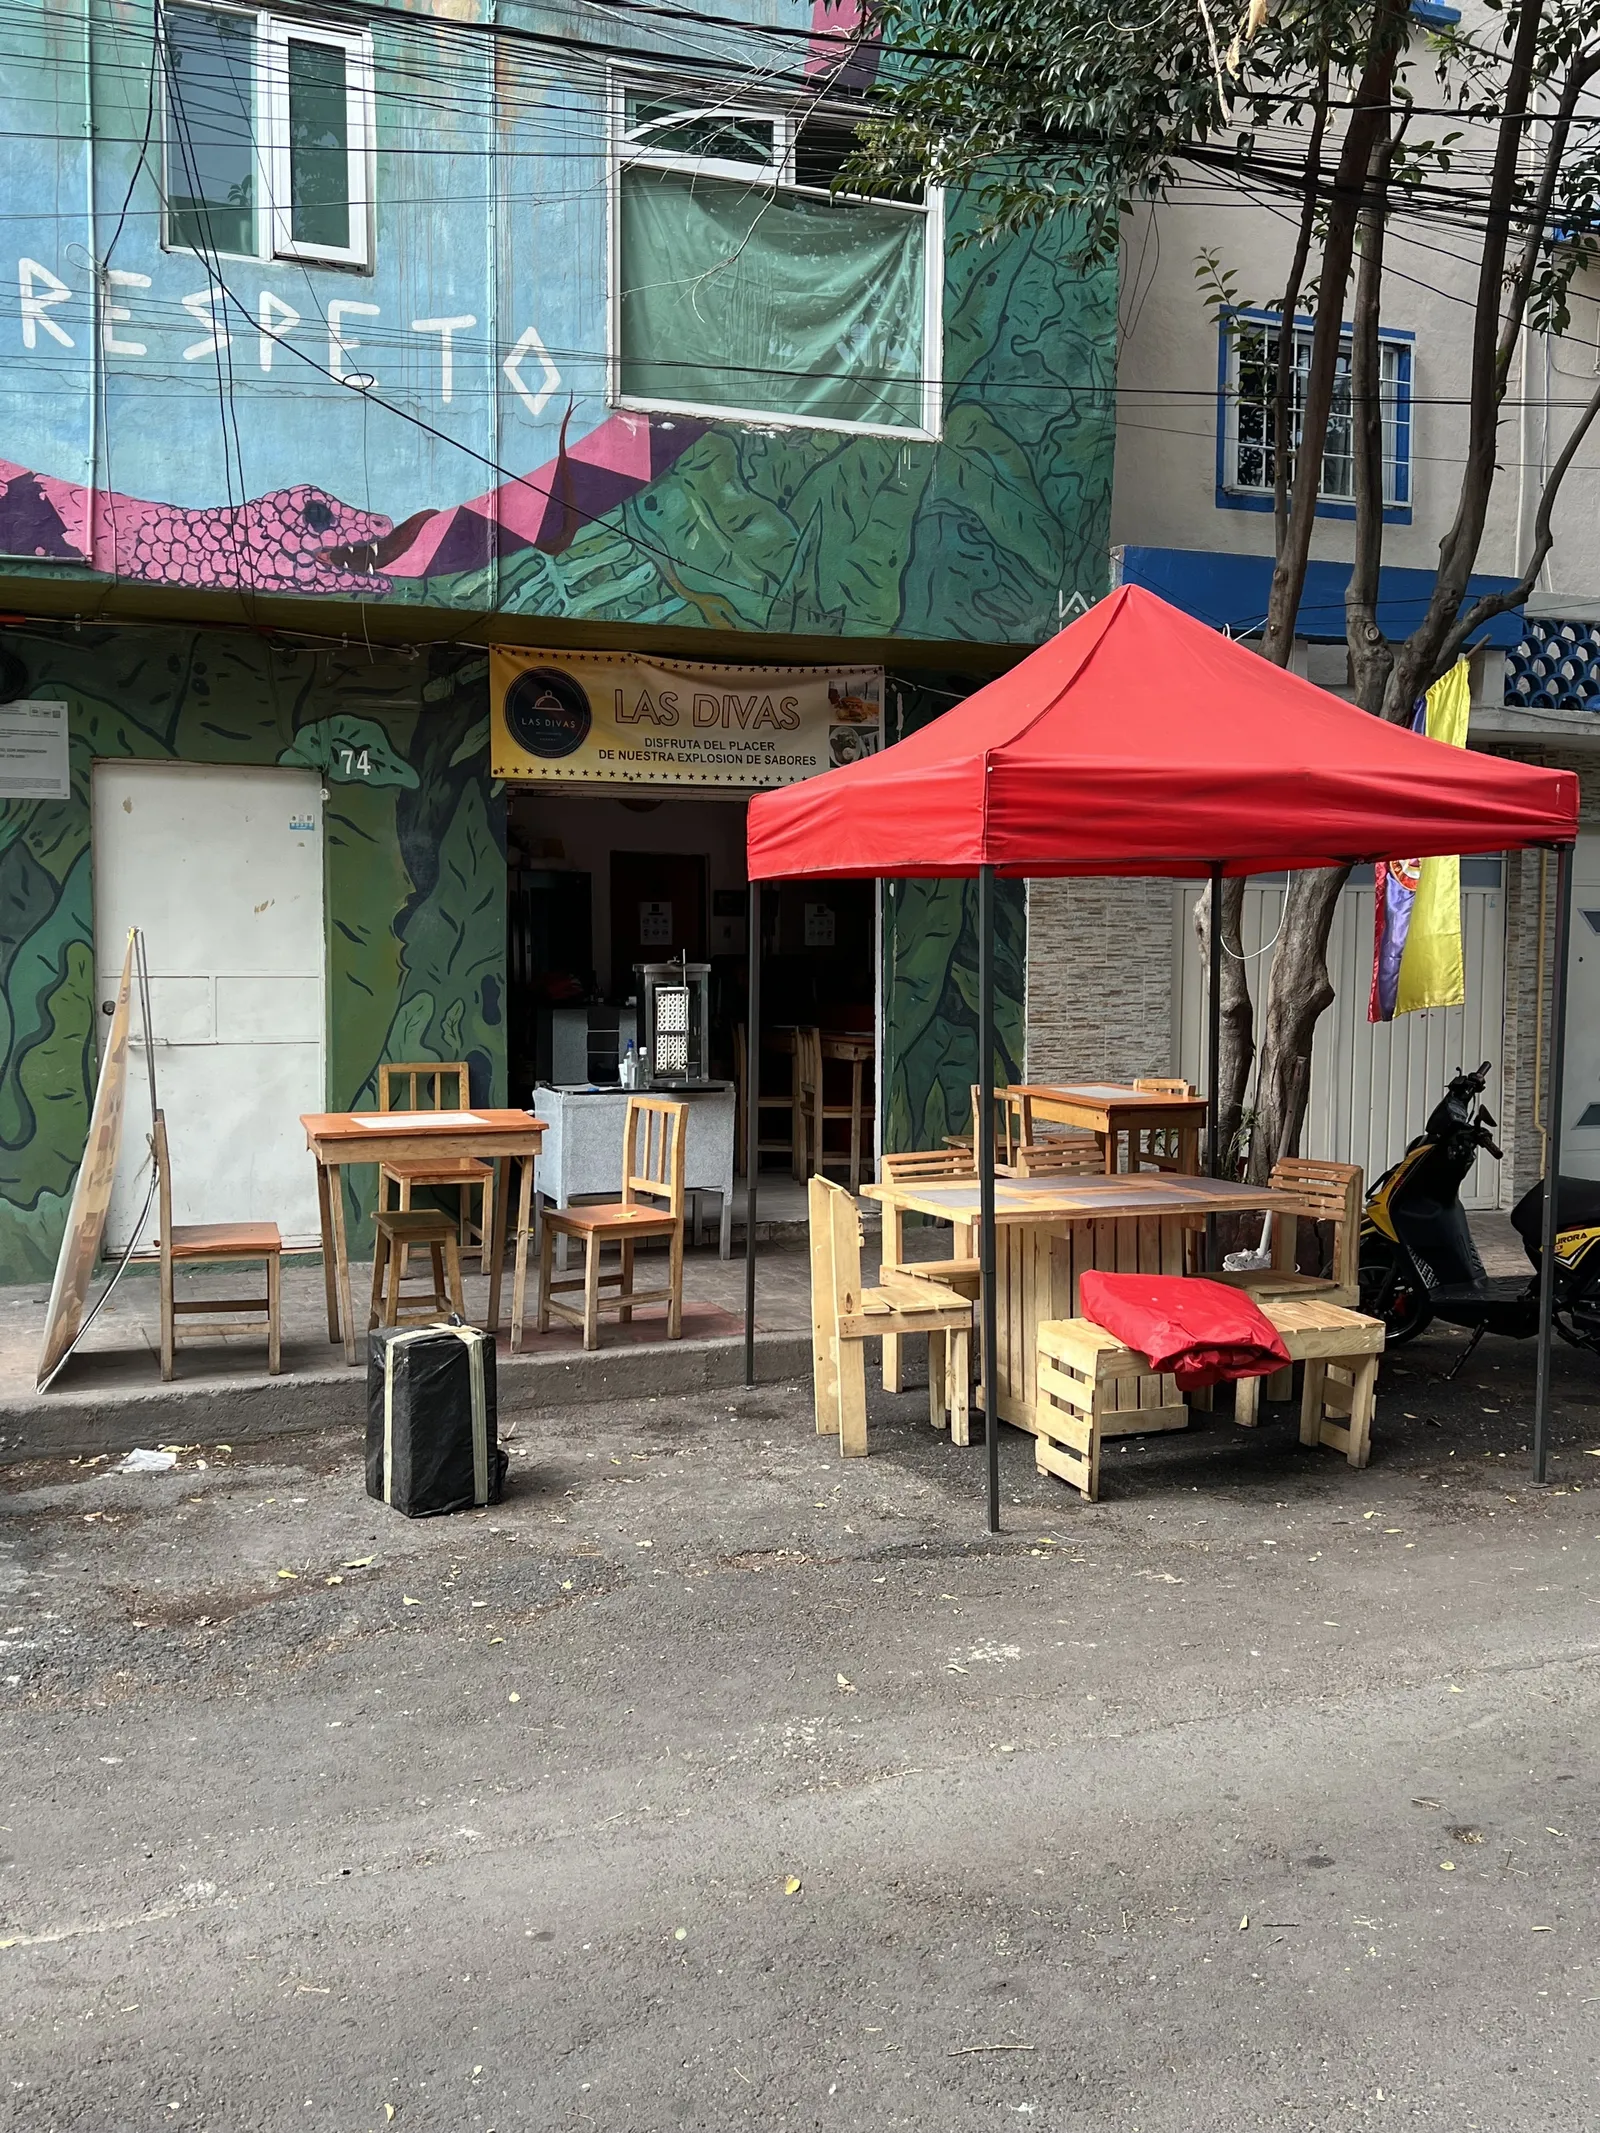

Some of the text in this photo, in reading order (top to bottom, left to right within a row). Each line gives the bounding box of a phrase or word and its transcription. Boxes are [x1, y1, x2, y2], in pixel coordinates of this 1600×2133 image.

[18, 257, 562, 415] RESPETO
[614, 688, 801, 731] LAS DIVAS
[521, 717, 576, 728] LAS DIVAS
[644, 737, 775, 751] DISFRUTA DEL PLACER
[340, 749, 372, 776] 74
[599, 749, 817, 766] DE NUESTRA EXPLOSION DE SABORES
[1557, 1232, 1588, 1244] URORA
